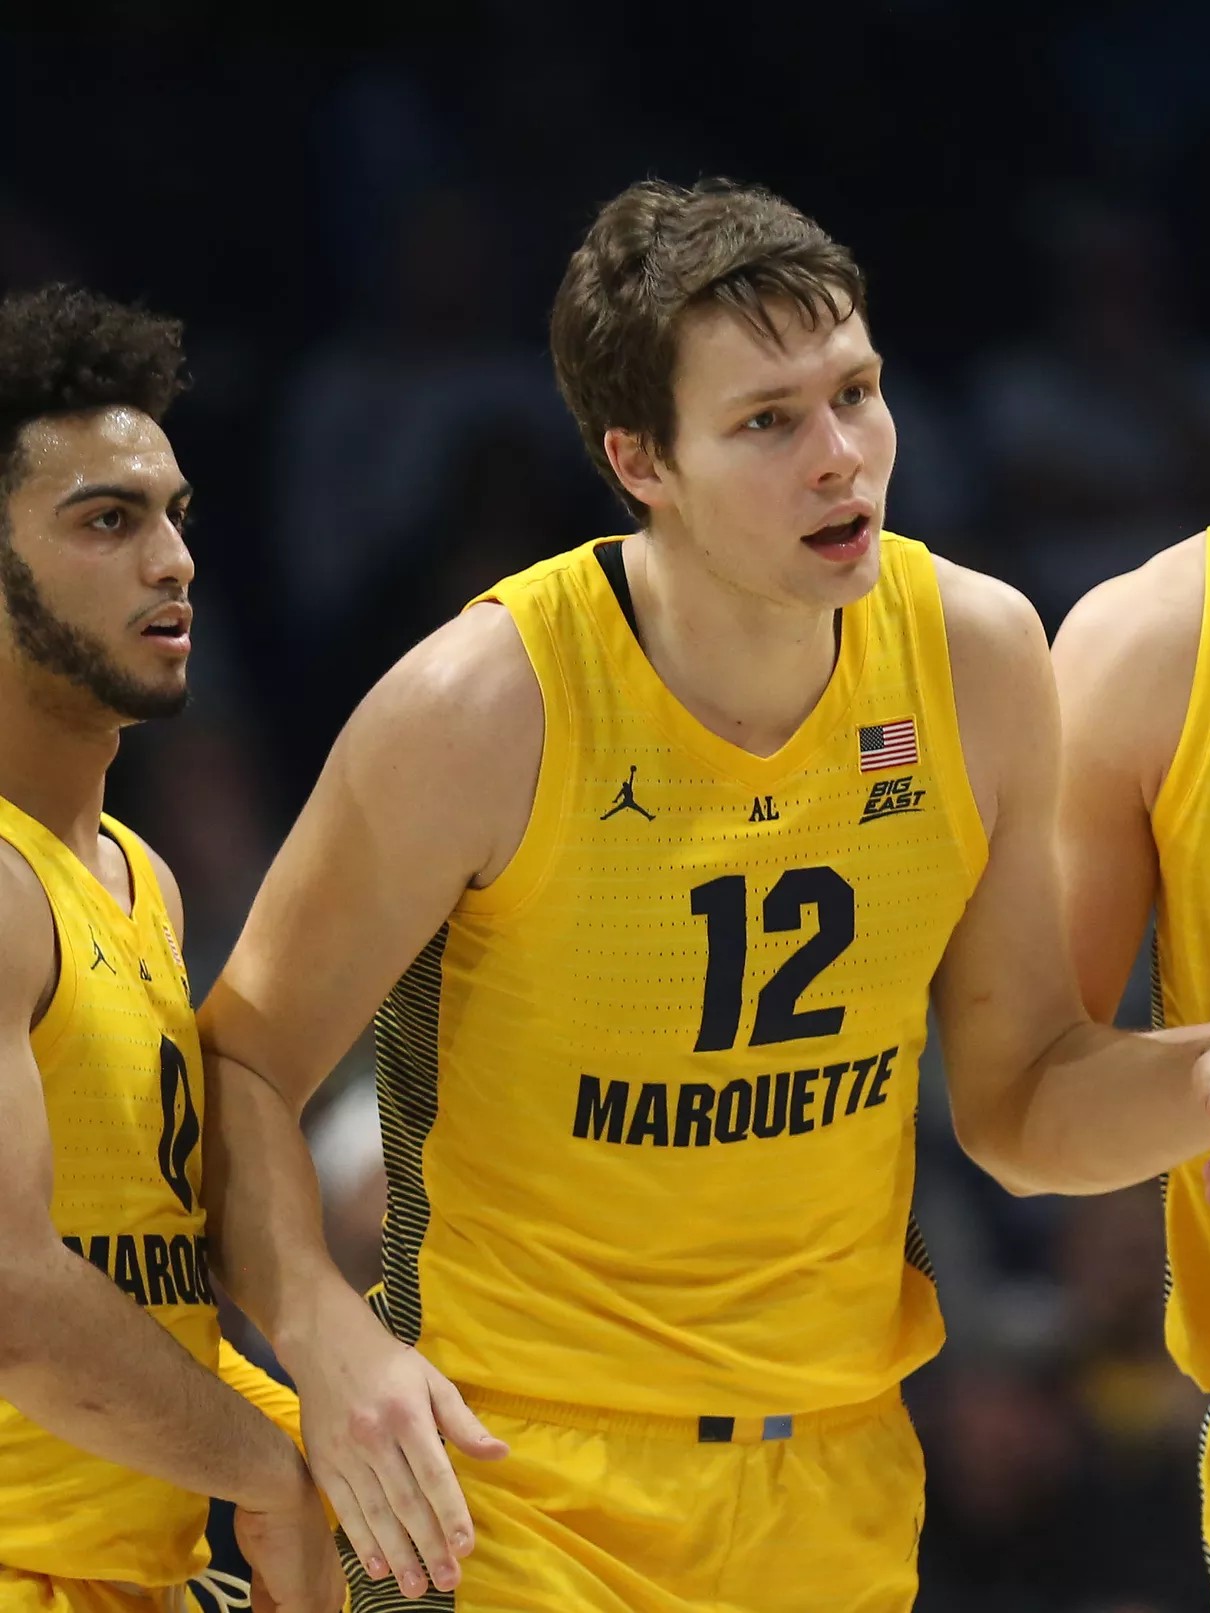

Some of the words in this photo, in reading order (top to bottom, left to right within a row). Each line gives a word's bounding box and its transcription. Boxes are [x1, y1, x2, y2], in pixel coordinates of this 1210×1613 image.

[748, 796, 780, 822] AL
[863, 790, 926, 815] EAST
[869, 776, 913, 799] BIG
[690, 866, 855, 1052] 12
[158, 1033, 200, 1214] 0
[573, 1047, 898, 1147] MARQUETTE
